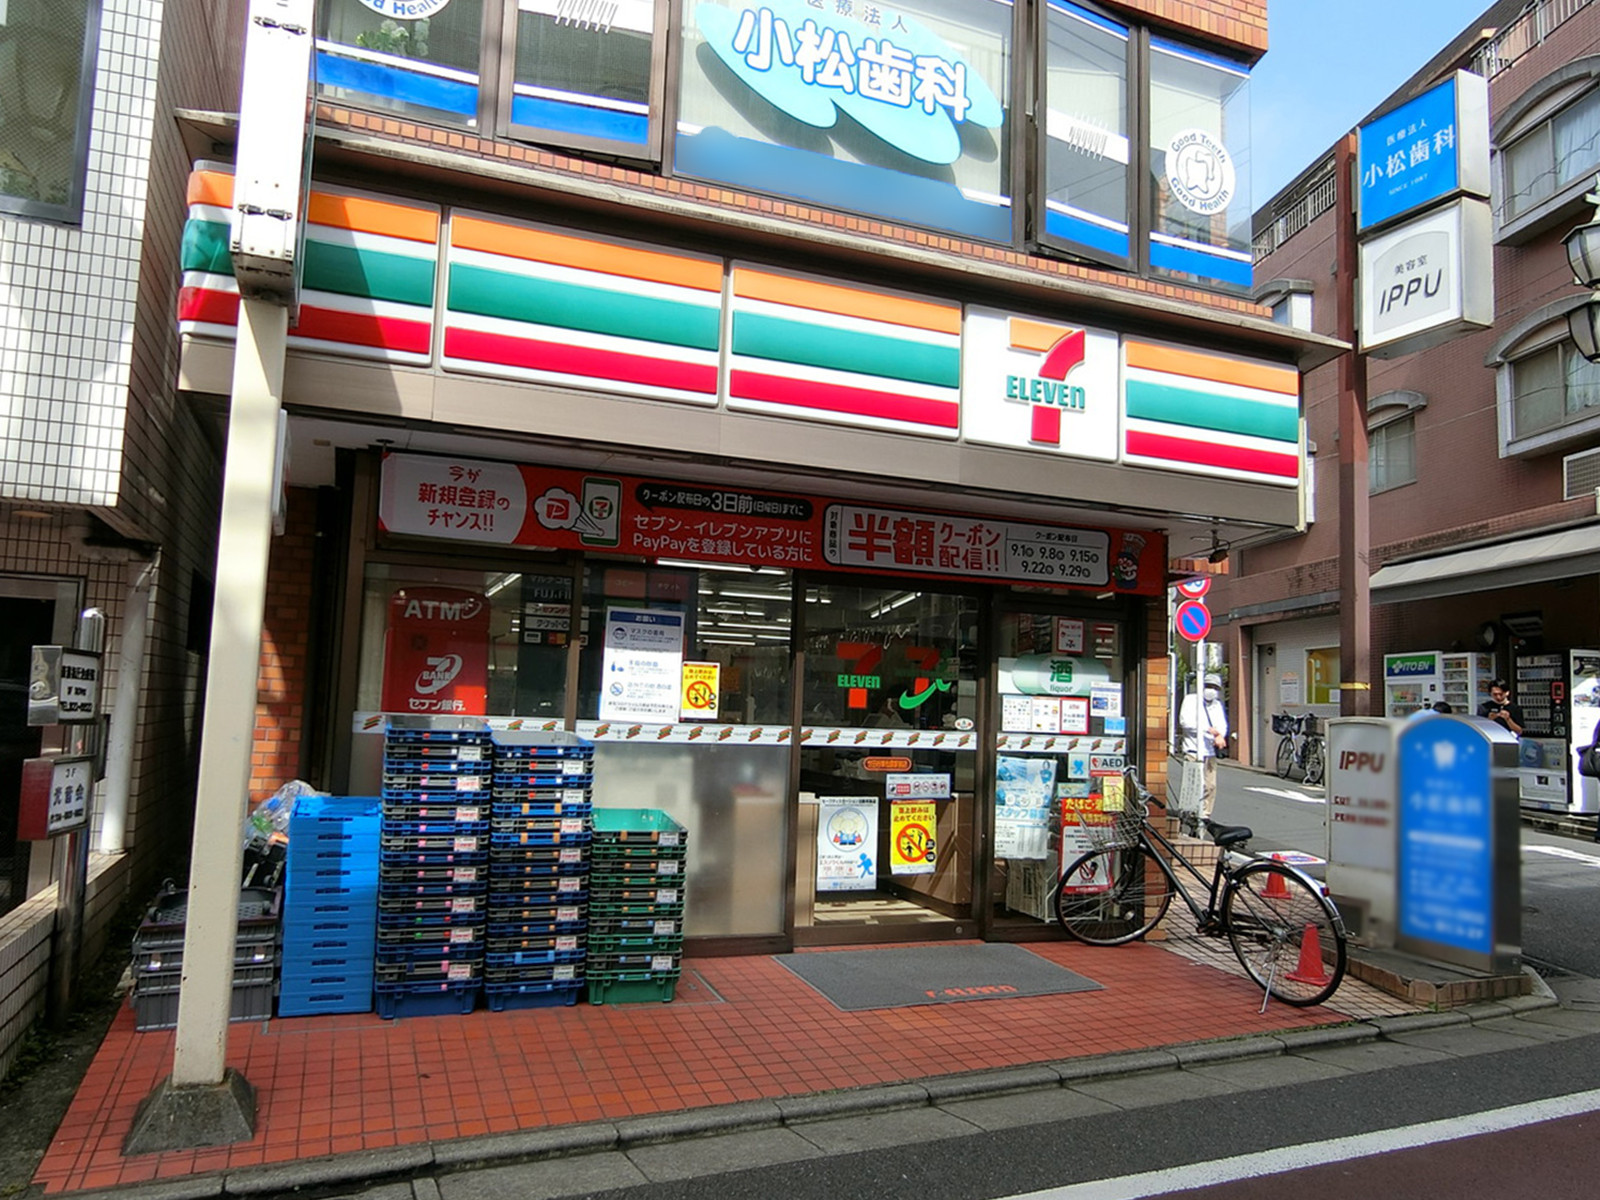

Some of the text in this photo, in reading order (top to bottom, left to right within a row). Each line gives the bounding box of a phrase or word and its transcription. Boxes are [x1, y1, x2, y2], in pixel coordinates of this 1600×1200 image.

[393, 0, 443, 15] Heal
[732, 7, 972, 121] 小松歯科
[1386, 118, 1428, 147] 医療法人
[1171, 132, 1226, 164] Good Teeth
[1363, 123, 1456, 188] 小松歯科
[1171, 177, 1230, 211] Good Health
[1394, 255, 1428, 276] 美容室
[1379, 268, 1443, 316] IPPU
[449, 465, 482, 484] 今が
[418, 482, 511, 511] 新規登録の
[427, 508, 494, 532] チャンス!!
[848, 513, 936, 566] 半額
[940, 522, 1001, 548] クーポン
[633, 532, 813, 562] PayPayを登録している方に
[939, 545, 1000, 572] 配信!!
[1011, 543, 1100, 564] 9.1 9.8 9.15
[1021, 560, 1091, 578] 9.22 9.29
[404, 599, 460, 621] ATM
[1050, 660, 1073, 682] 酒
[1050, 685, 1073, 694] liquor
[408, 697, 464, 711] セブン銀行
[1101, 758, 1123, 768] AED
[1339, 750, 1384, 773] IPPU
[893, 814, 935, 823] 止めてください
[996, 807, 1046, 819] スタッフ募集
